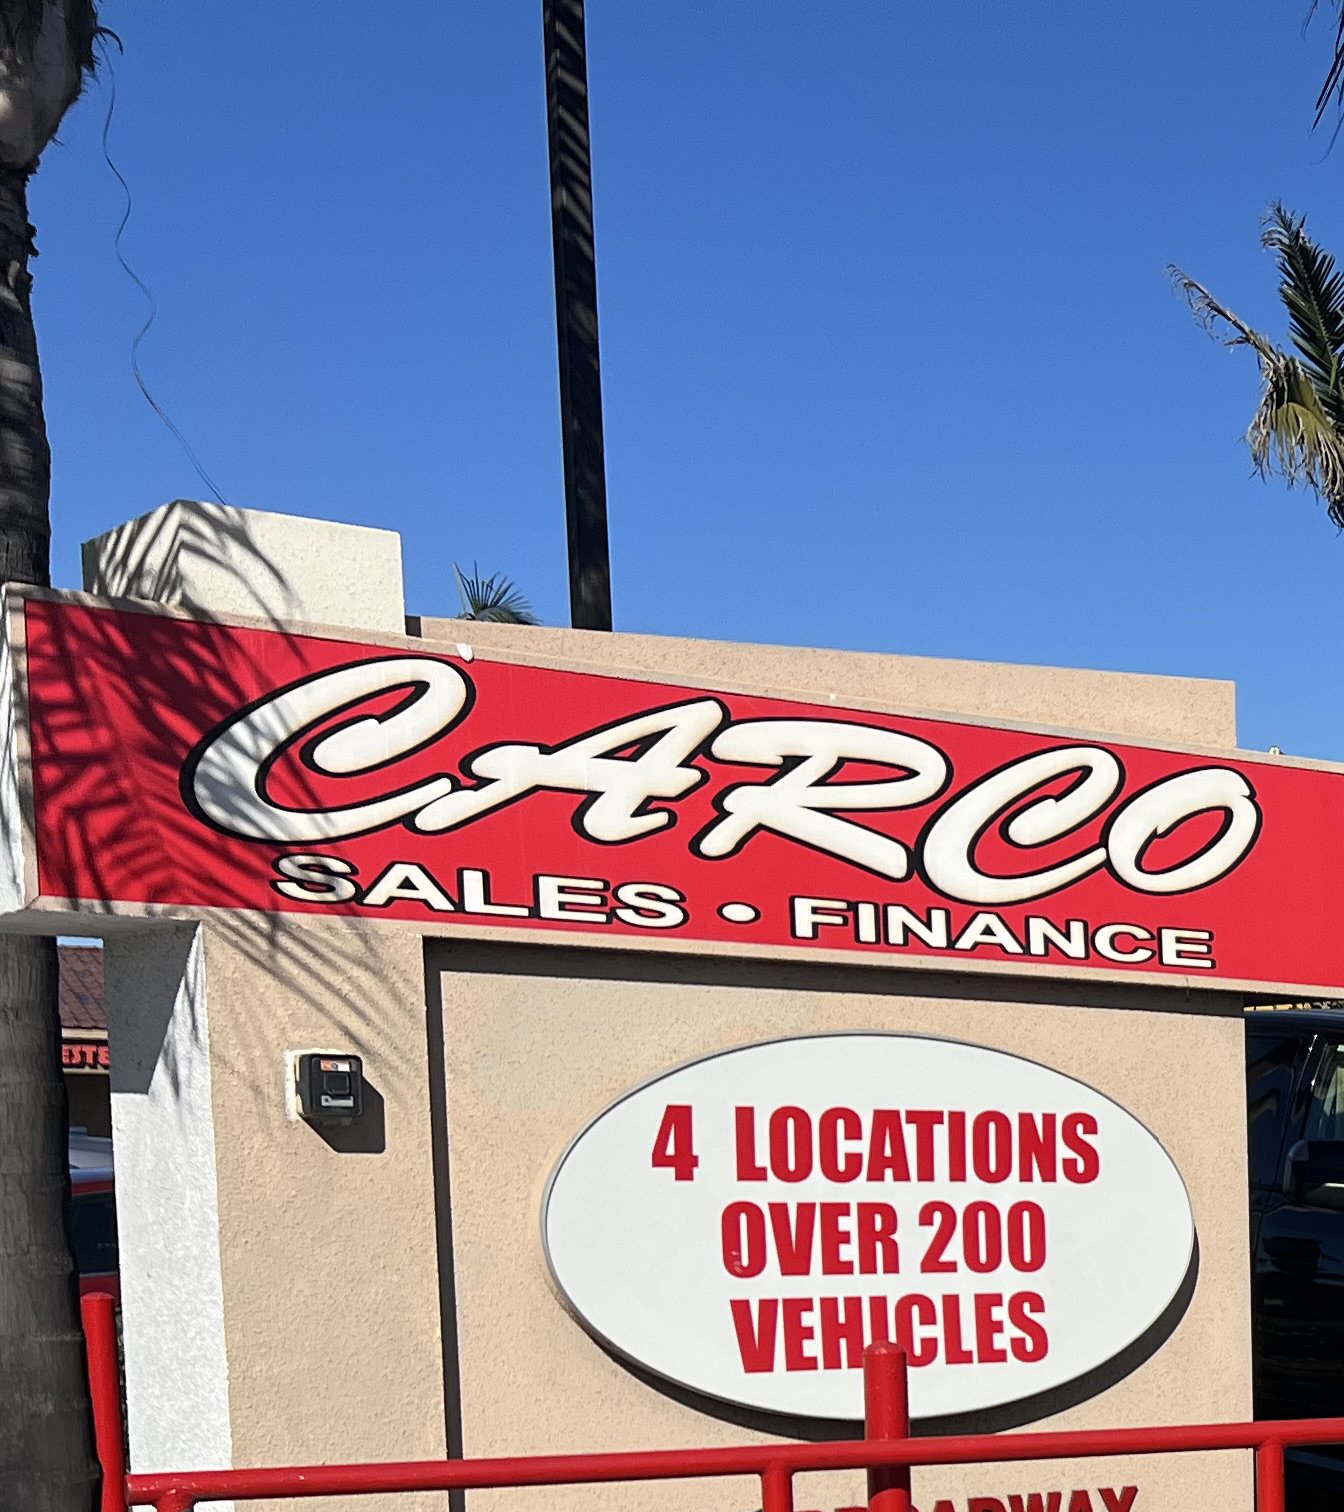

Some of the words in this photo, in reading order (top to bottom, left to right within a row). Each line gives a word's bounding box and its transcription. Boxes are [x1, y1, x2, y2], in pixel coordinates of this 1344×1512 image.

[182, 655, 1262, 902] CARCO
[271, 852, 688, 930] SALES
[790, 895, 1216, 971] FINANCE
[652, 1104, 700, 1182] 4
[734, 1104, 1101, 1185] LOCATIONS
[721, 1200, 899, 1278] OVER
[918, 1200, 1047, 1275] 200
[729, 1290, 1050, 1374] VEHICLES
